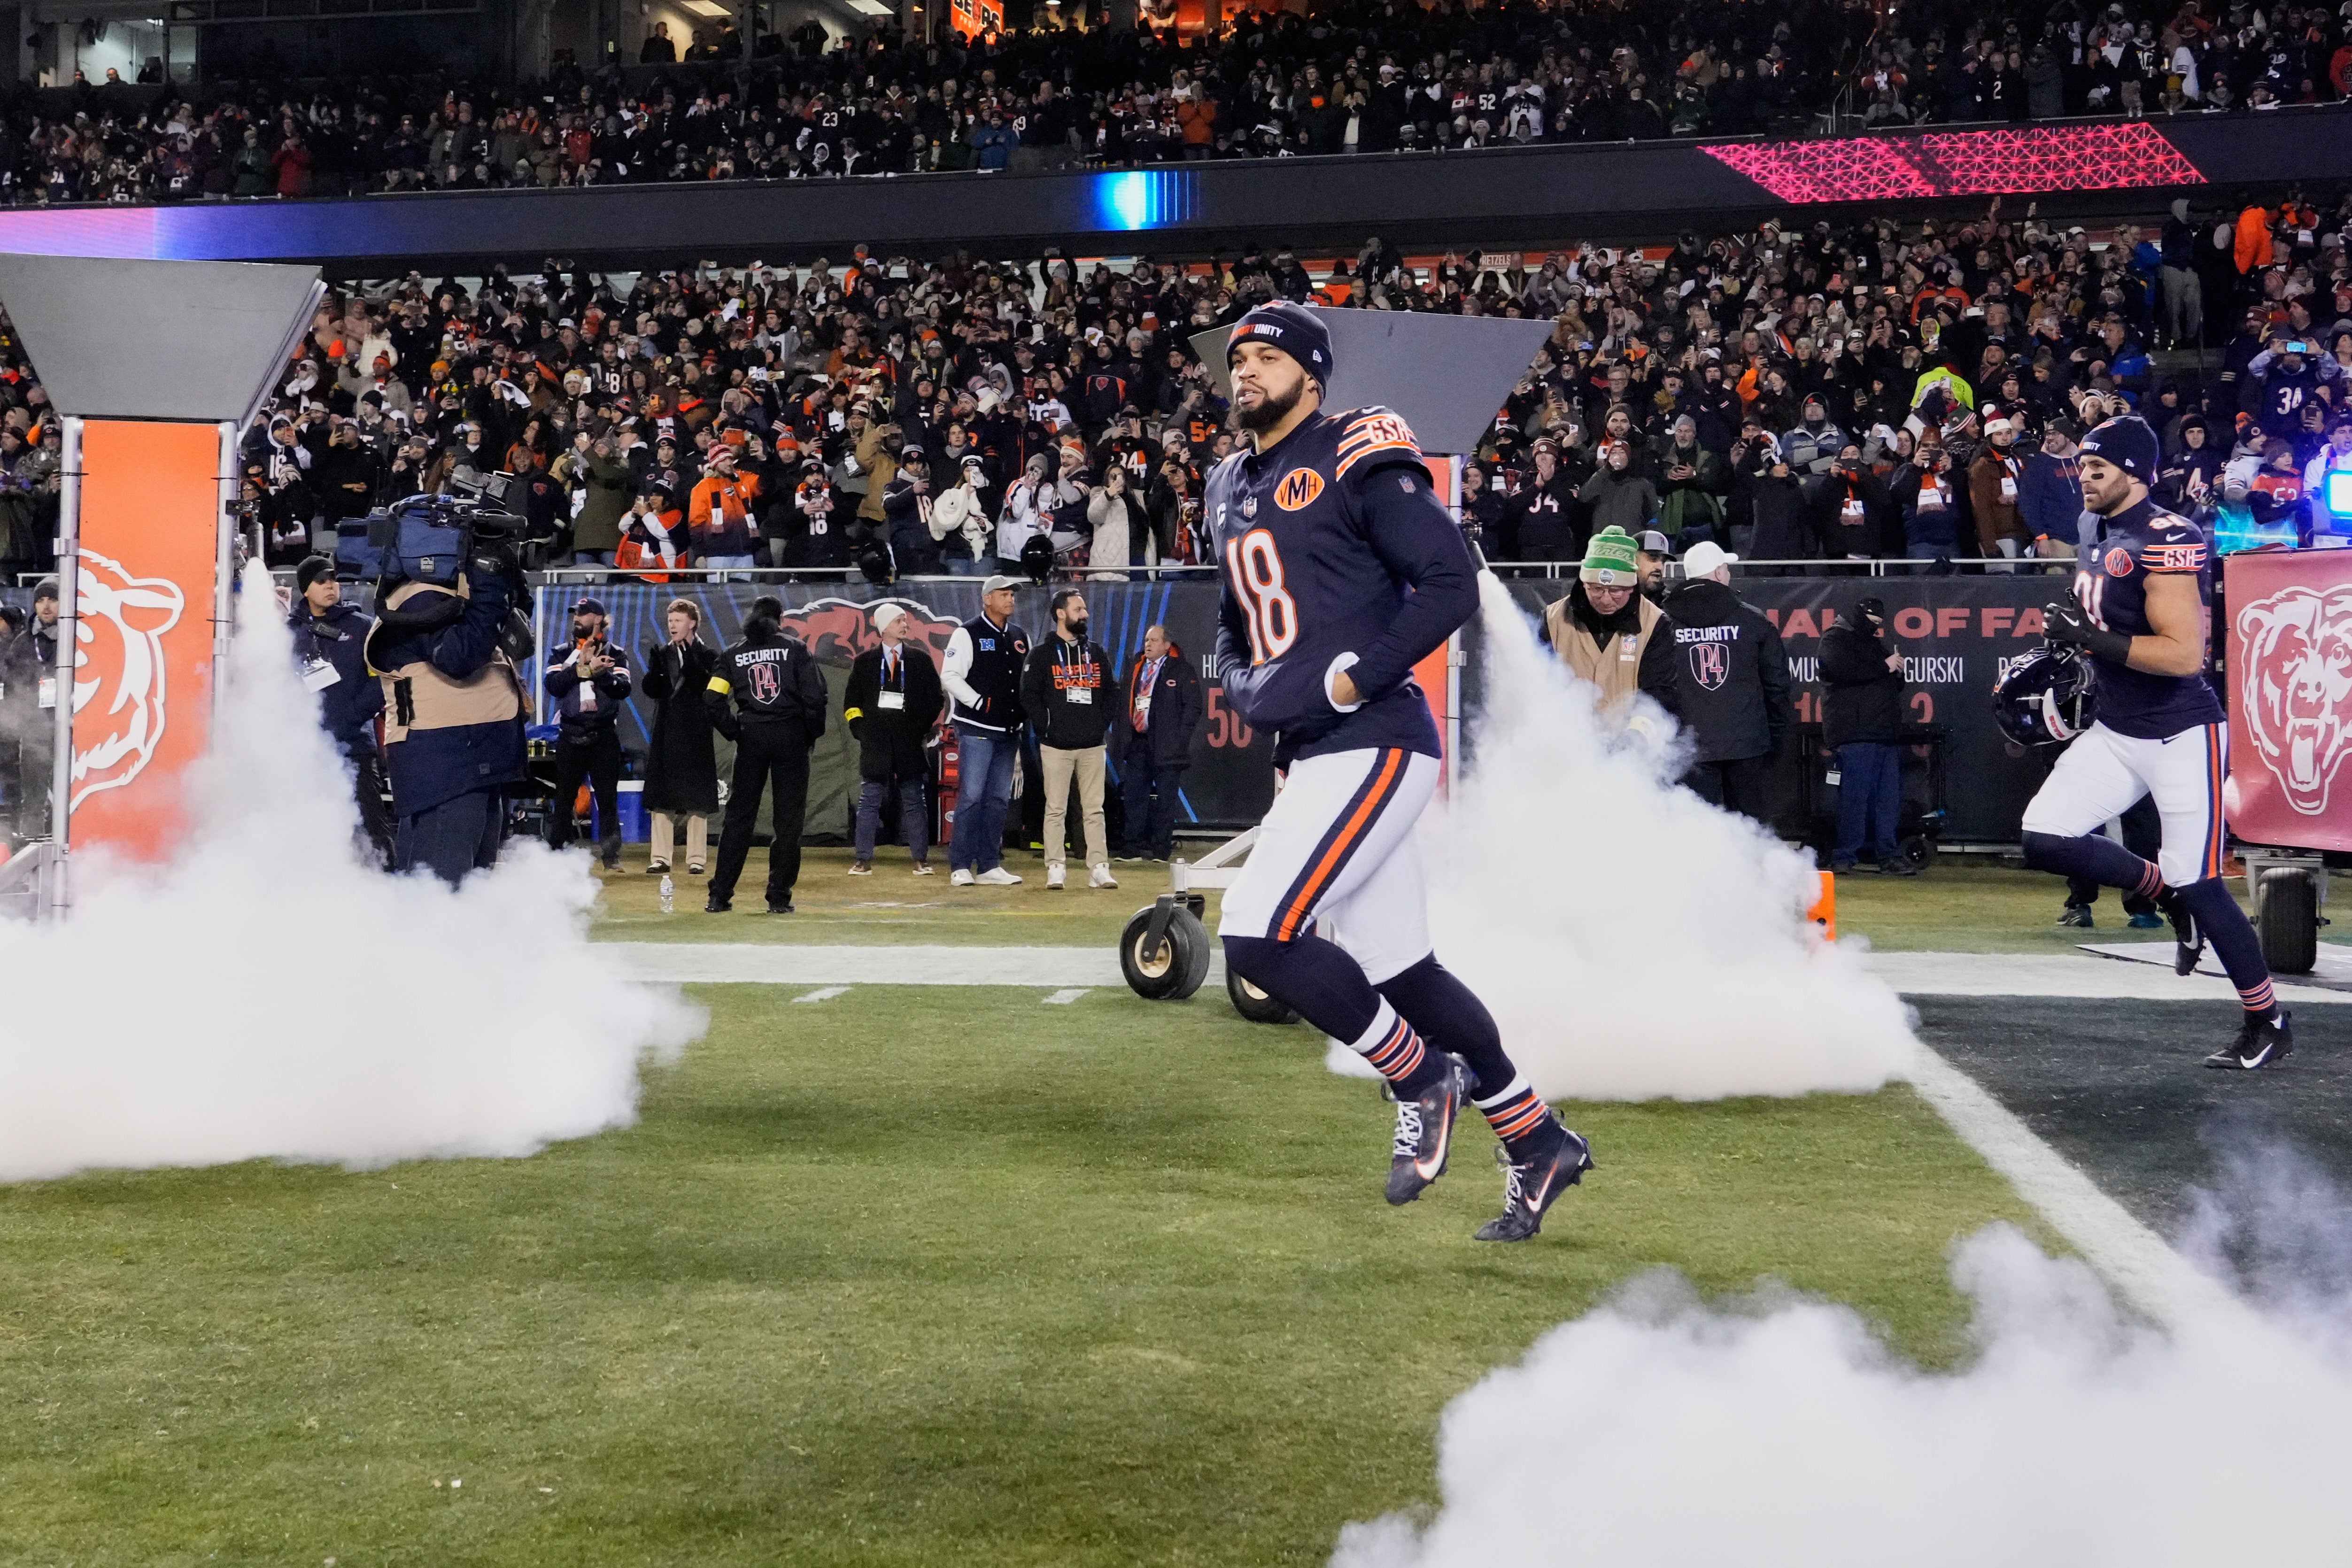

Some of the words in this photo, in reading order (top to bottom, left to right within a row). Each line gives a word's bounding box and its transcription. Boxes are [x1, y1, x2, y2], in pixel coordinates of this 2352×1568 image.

[1479, 93, 1496, 110] 52
[822, 112, 838, 127] 23
[605, 372, 620, 394] 18
[1366, 417, 1410, 444] GSH
[1280, 471, 1317, 507] VMH
[2163, 548, 2196, 567] GSH
[1227, 528, 1298, 665] 18
[1894, 607, 1970, 638] OF
[1981, 608, 2045, 638] FA
[1676, 625, 1739, 643] SECURITY
[735, 648, 789, 667] SECURITY
[1698, 643, 1724, 683] P4
[1052, 663, 1100, 676] INSPIRE
[1903, 657, 1964, 682] GURSKI
[752, 663, 777, 699] P4
[1054, 676, 1101, 689] CHANGE
